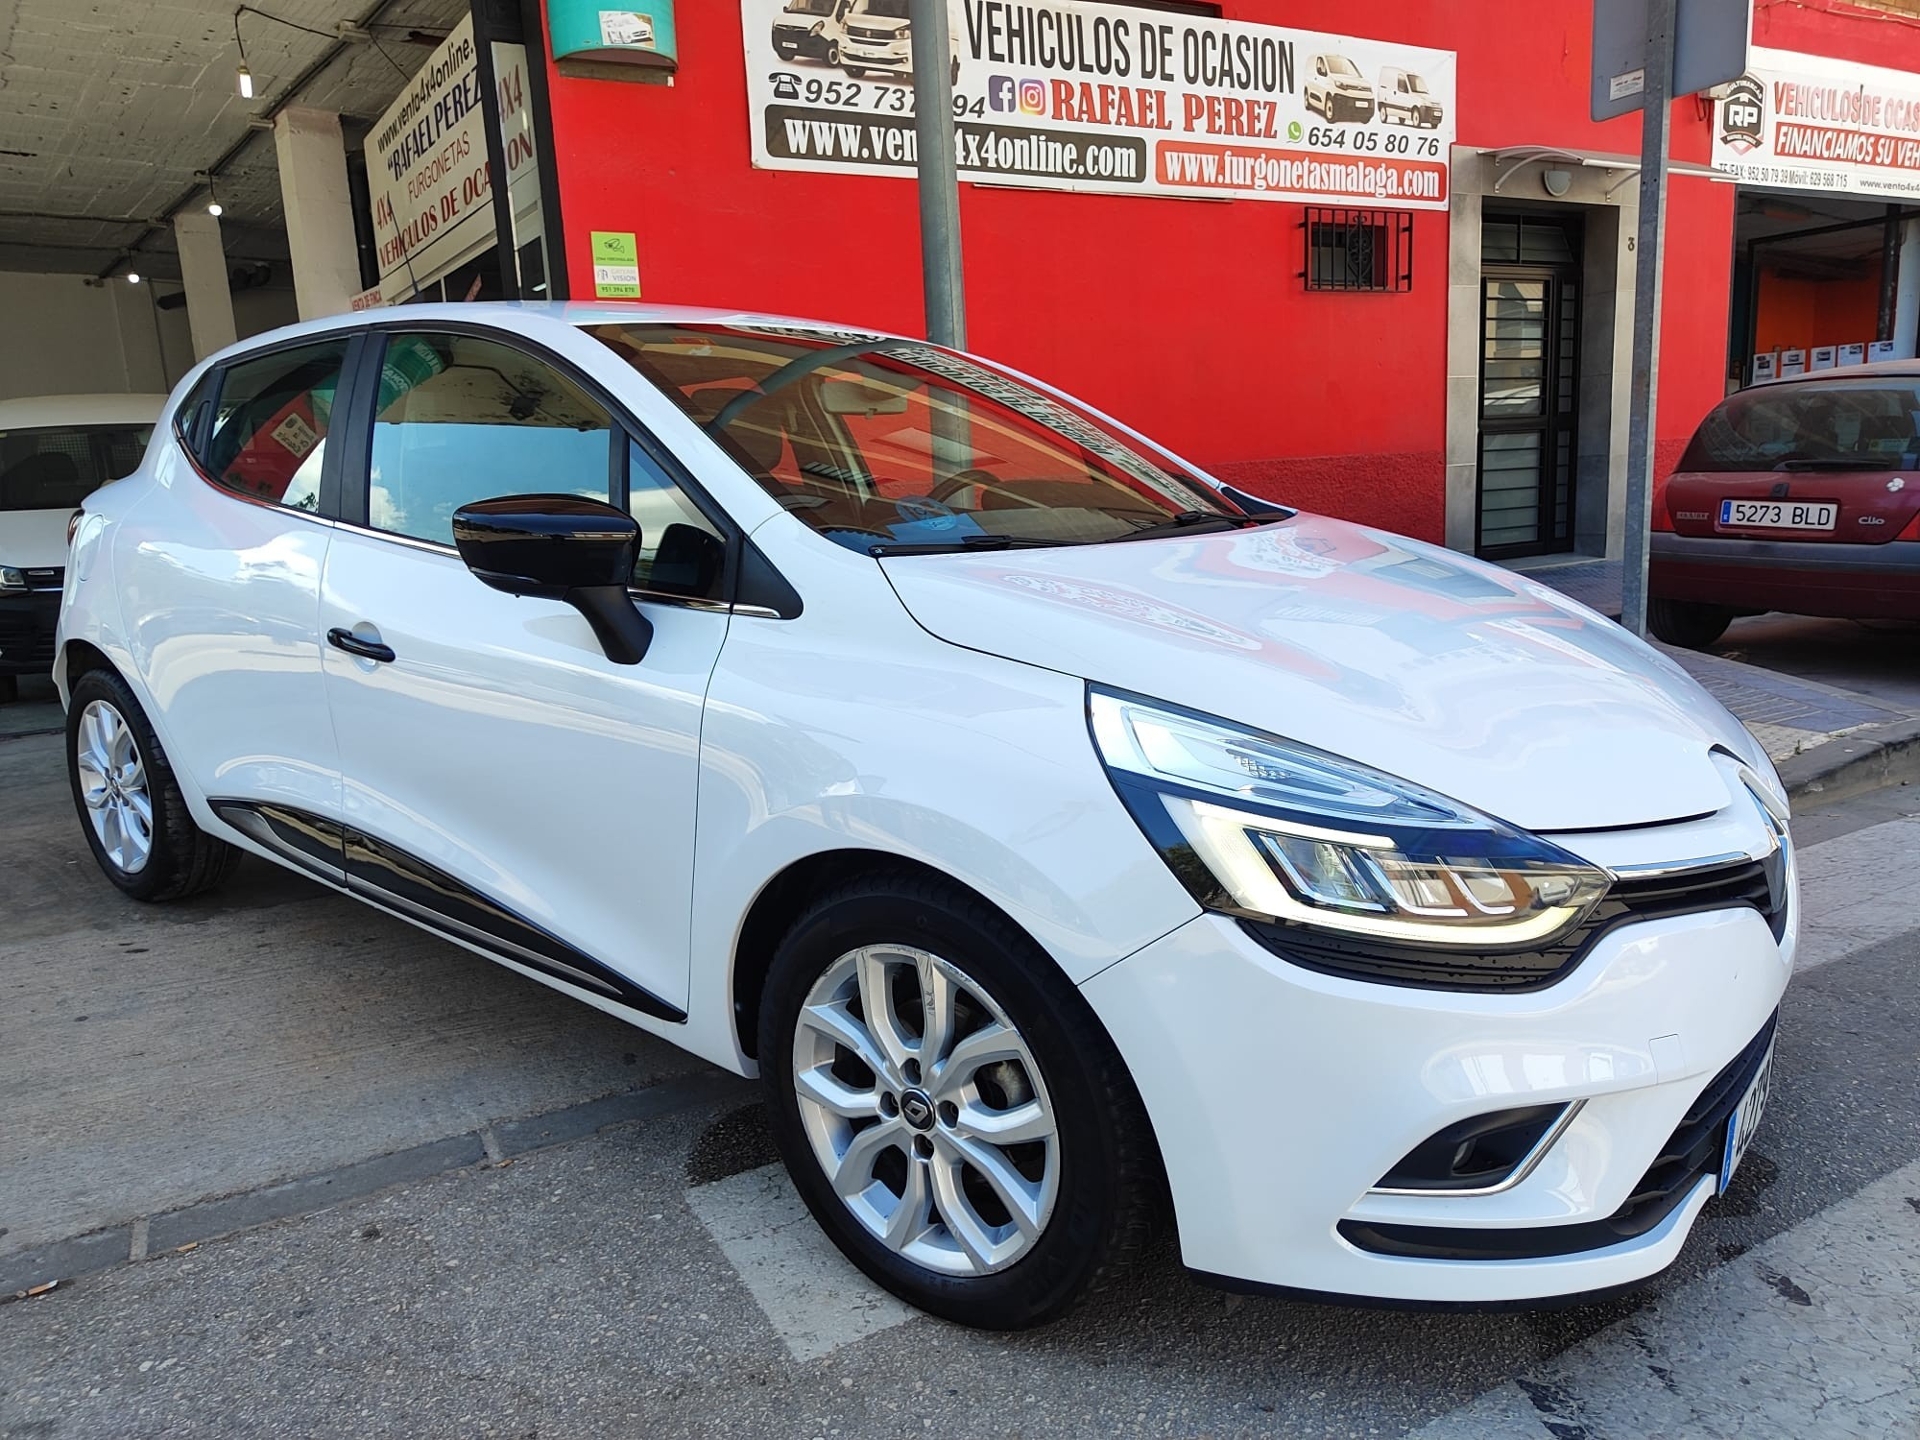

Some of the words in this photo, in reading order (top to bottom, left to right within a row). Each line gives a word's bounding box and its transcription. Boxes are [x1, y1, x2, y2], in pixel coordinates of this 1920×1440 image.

[965, 0, 1130, 77] VEHICULOS
[1140, 22, 1174, 82] DE
[1182, 28, 1295, 94] OCASION
[804, 79, 862, 107] 952
[1050, 79, 1172, 131] RAFAEL
[1182, 93, 1278, 139] PEREZ
[1728, 104, 1759, 127] RP
[1774, 81, 1860, 123] VEHICULOS
[1862, 94, 1881, 127] DE
[784, 118, 1137, 179] www.ven4x4online.com
[1308, 126, 1346, 149] 654
[1353, 131, 1378, 151] 05
[1385, 133, 1409, 153] 80
[1417, 137, 1440, 156] 76
[1776, 125, 1875, 163] FINANCIAMOS
[1877, 137, 1895, 165] SU
[407, 130, 471, 204] FURGONETAS
[1164, 150, 1440, 199] www.furgonetasmalaga.com
[378, 205, 438, 268] VEHICULOS
[440, 187, 460, 223] DE
[1735, 504, 1781, 523] 5273
[1792, 506, 1831, 527] BLD
